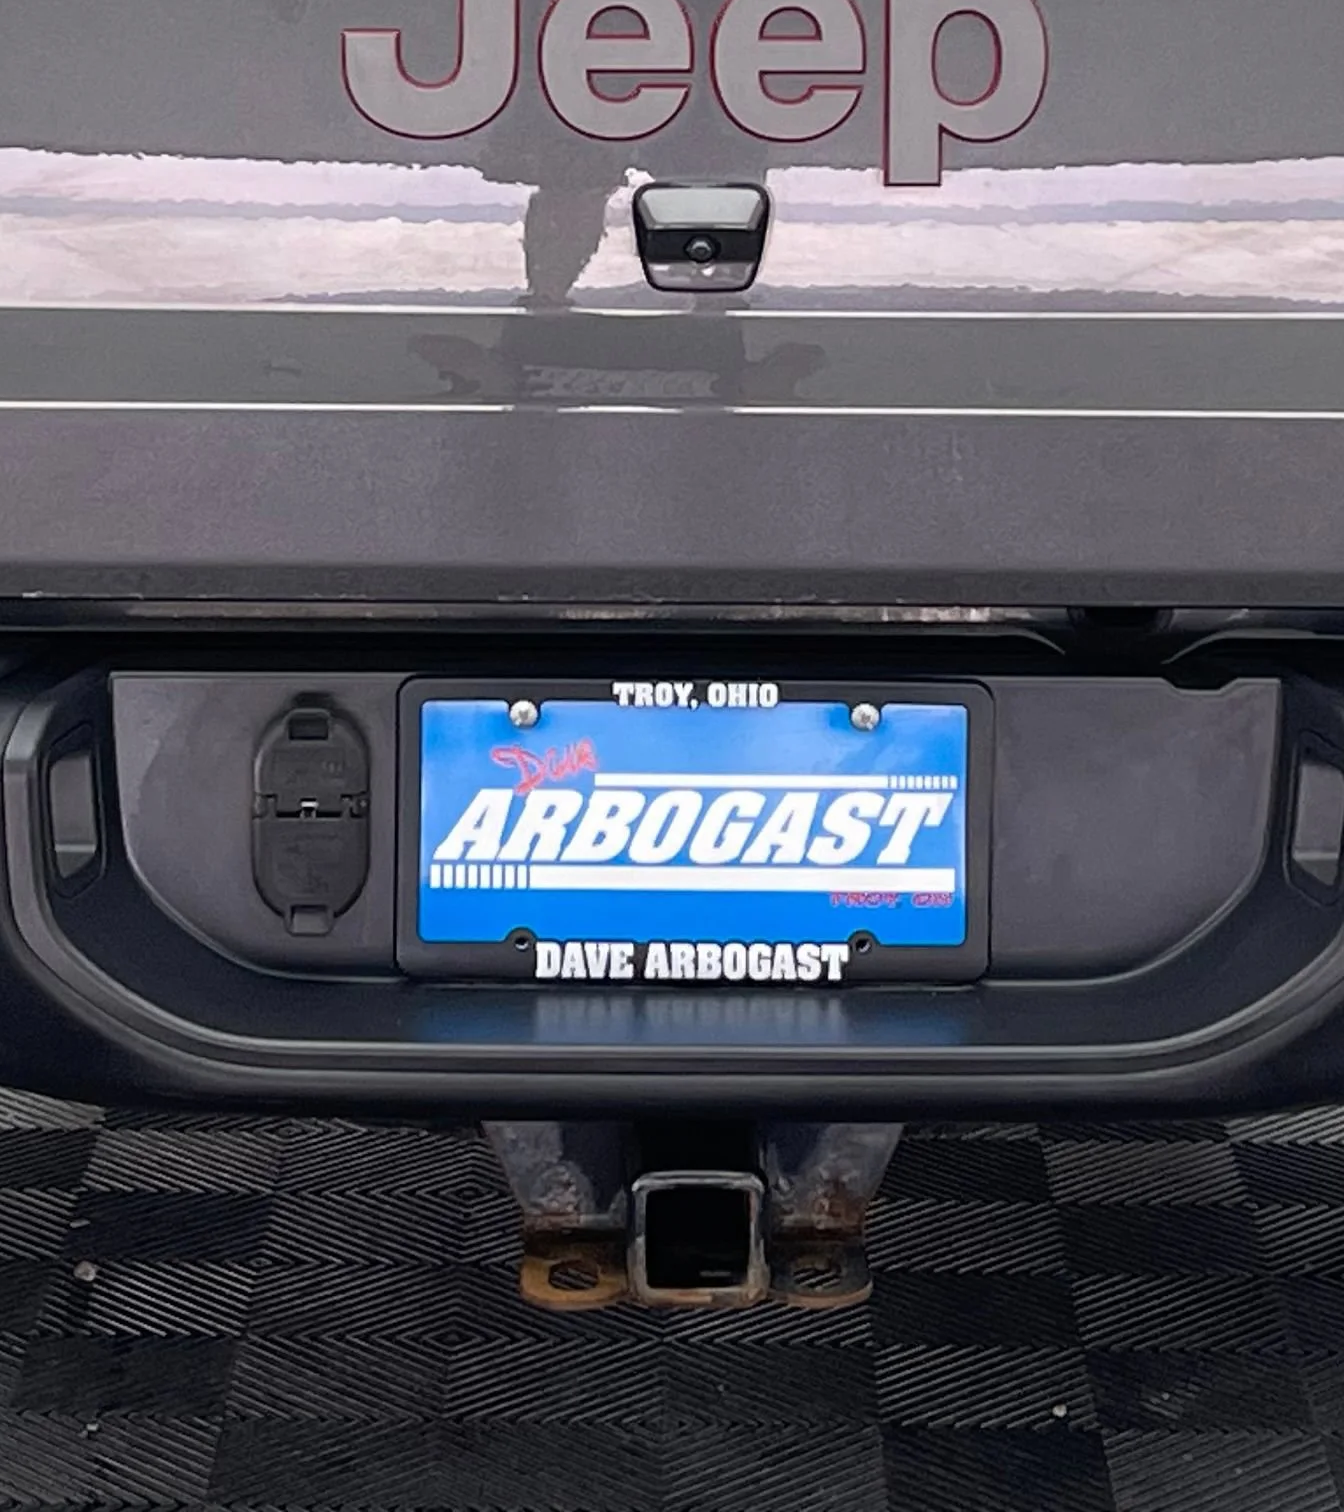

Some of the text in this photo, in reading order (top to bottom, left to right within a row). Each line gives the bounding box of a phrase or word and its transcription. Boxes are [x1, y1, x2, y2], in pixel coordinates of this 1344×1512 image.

[612, 681, 778, 710] TROY, OHIO
[433, 788, 953, 865] ARBOGAST
[535, 941, 849, 981] DAVE ARBOGAST
